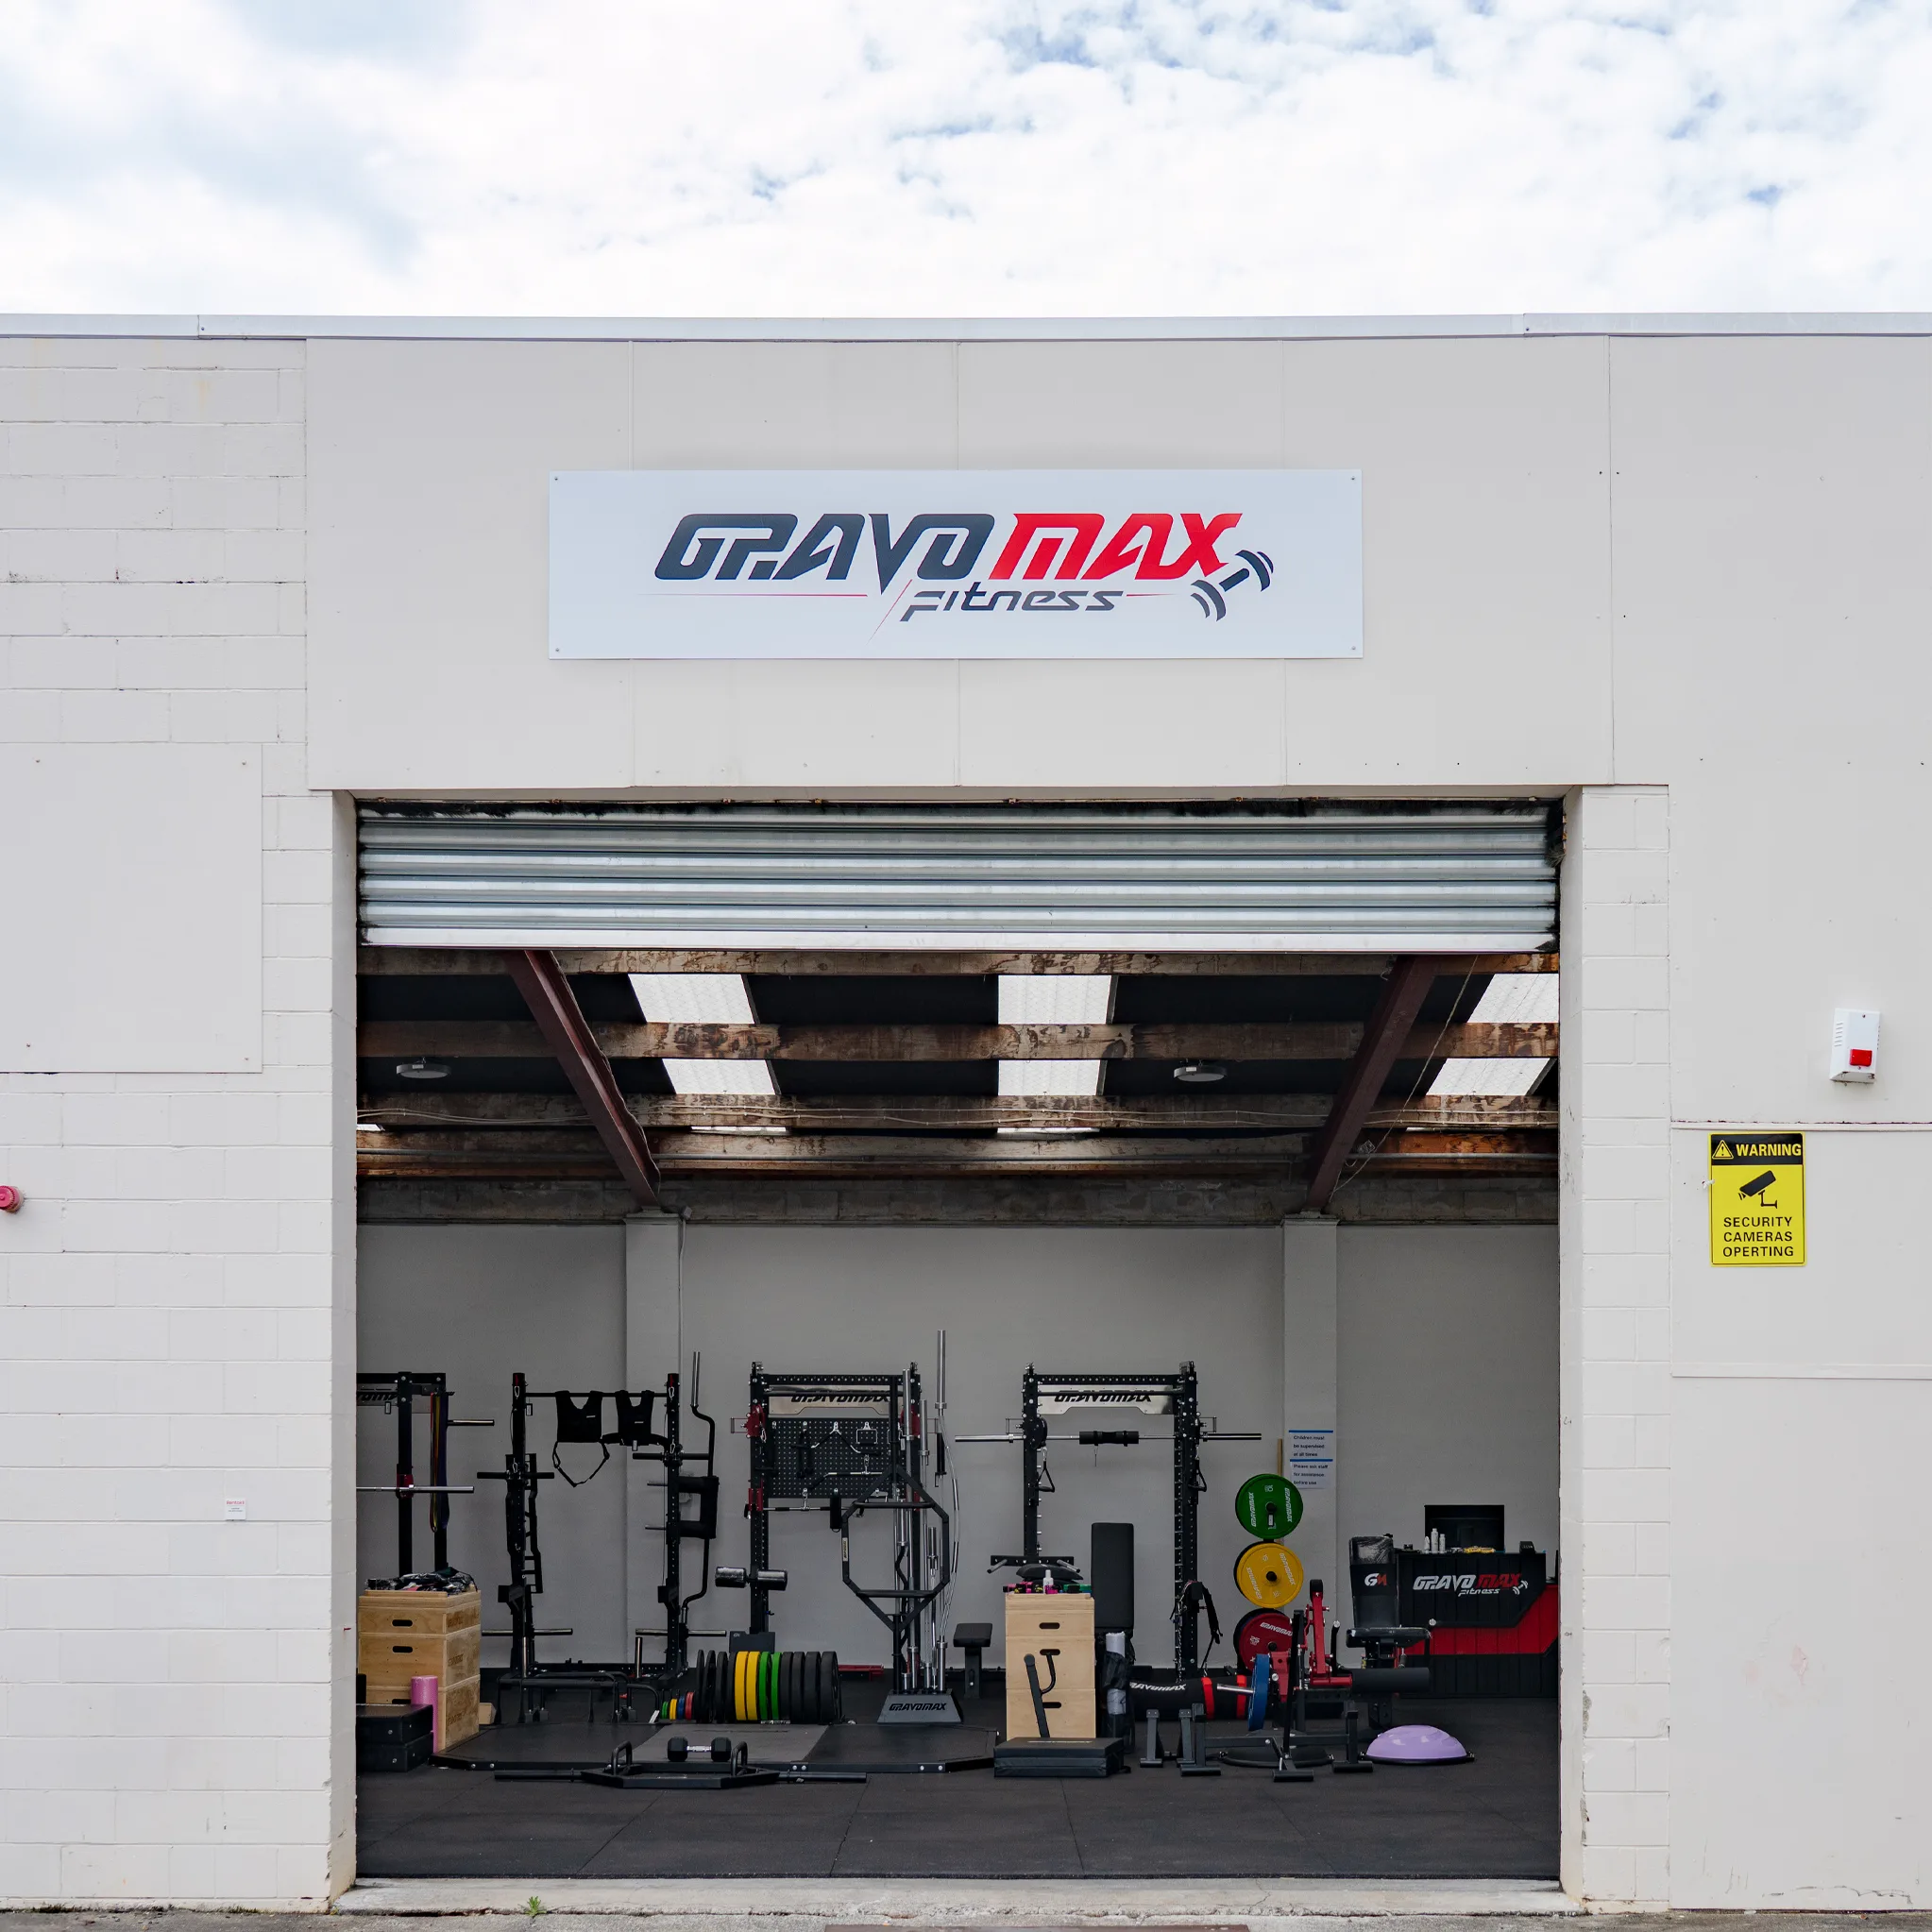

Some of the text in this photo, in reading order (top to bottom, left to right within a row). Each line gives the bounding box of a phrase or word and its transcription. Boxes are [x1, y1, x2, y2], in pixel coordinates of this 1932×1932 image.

[1736, 1144, 1803, 1157] WARNING
[1723, 1216, 1792, 1228] SECURITY
[1723, 1231, 1793, 1243] CAMERAS
[1722, 1246, 1794, 1258] OPERTING
[1260, 1621, 1293, 1636] GRAVOMA
[1129, 1682, 1186, 1691] RAVOMAX
